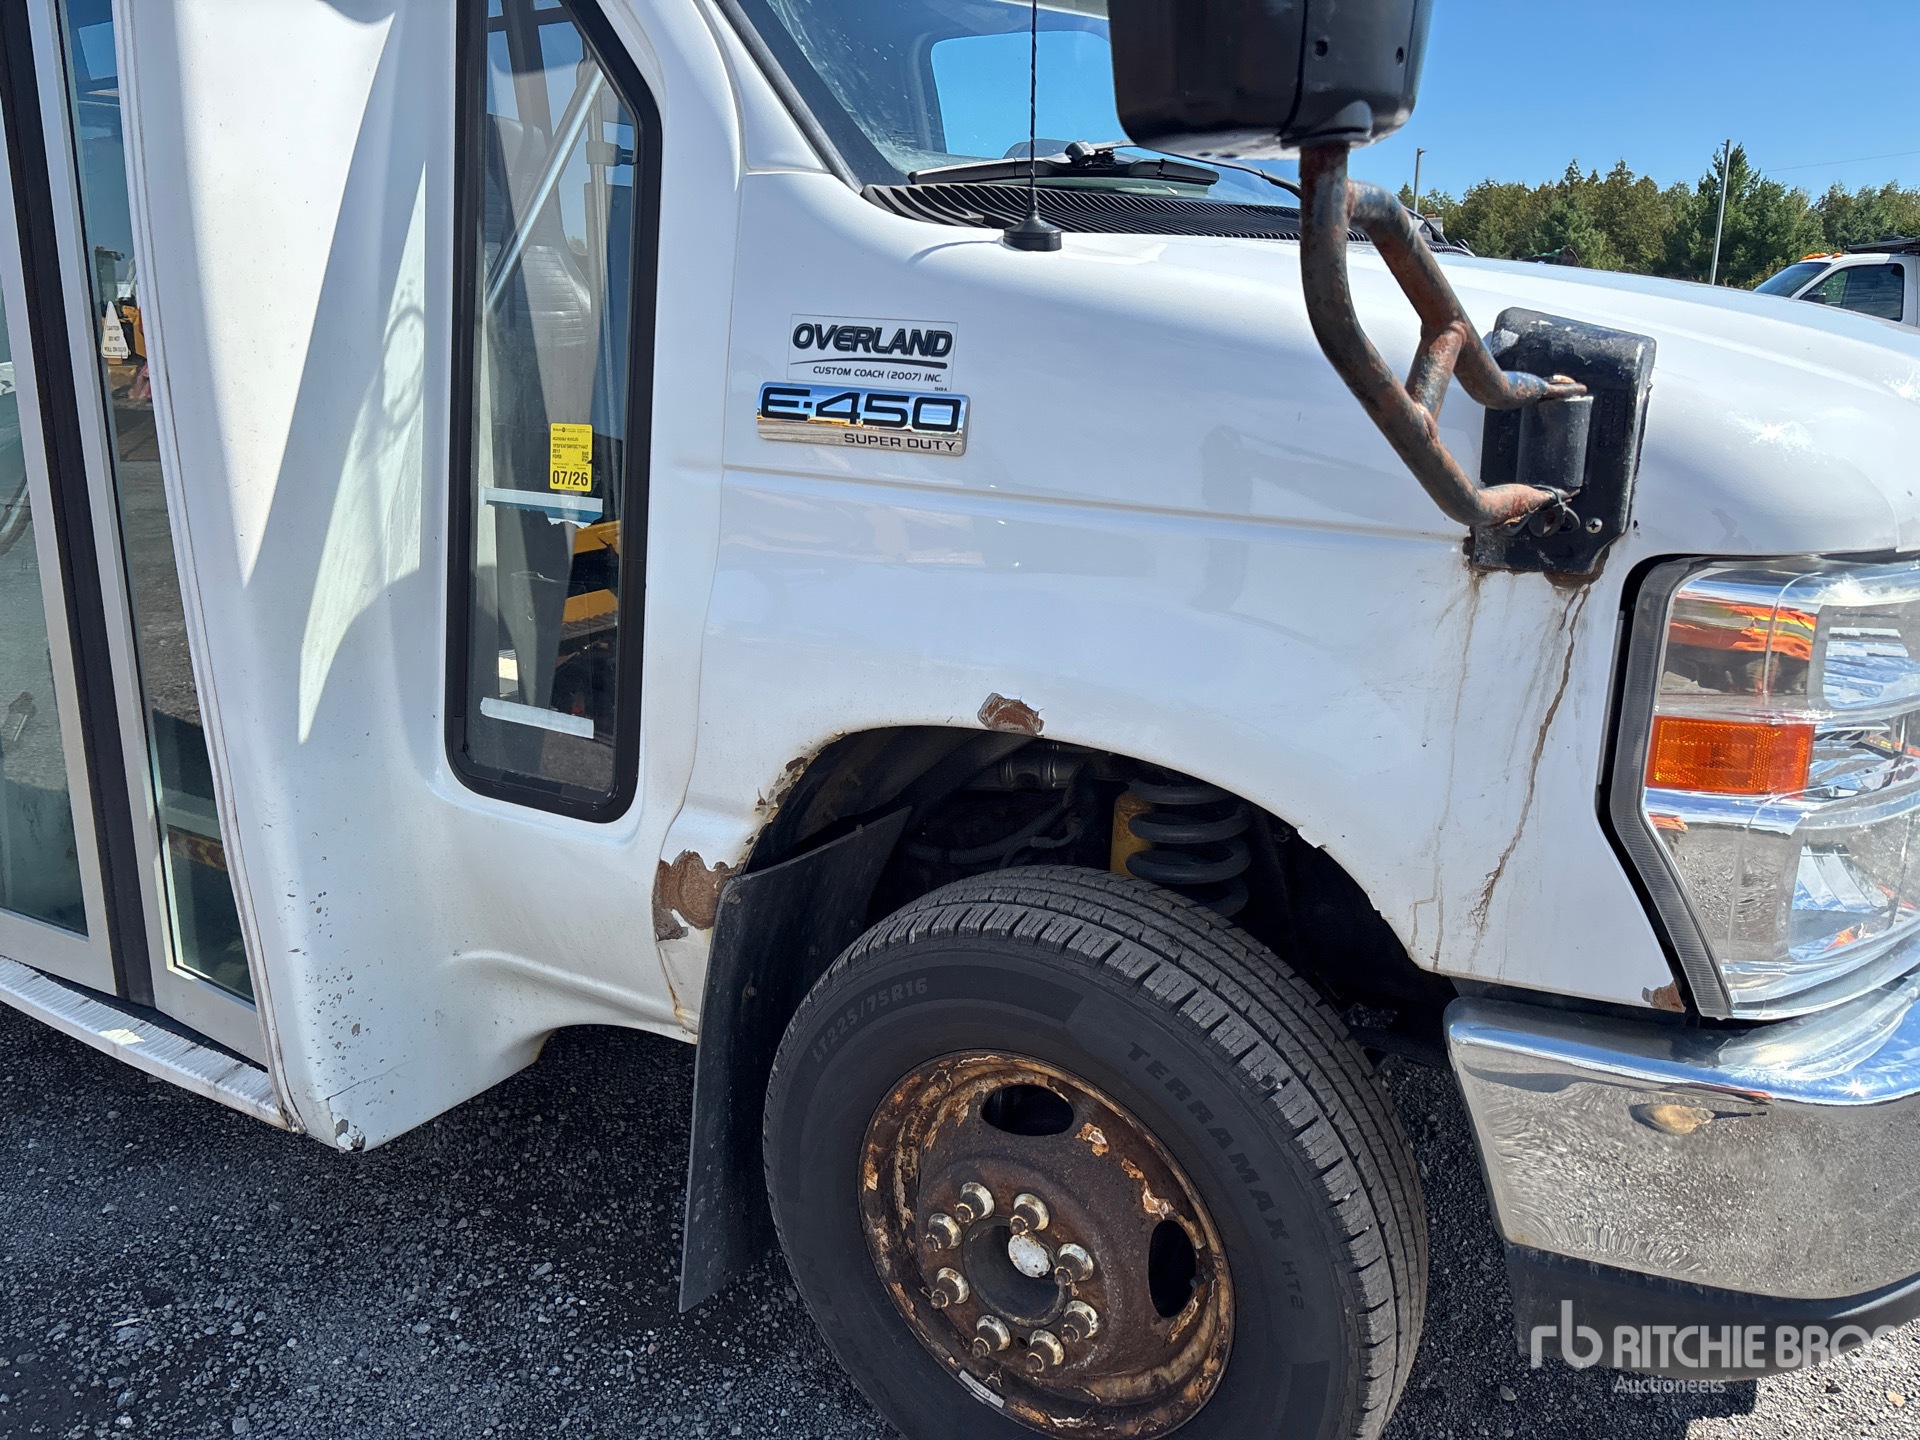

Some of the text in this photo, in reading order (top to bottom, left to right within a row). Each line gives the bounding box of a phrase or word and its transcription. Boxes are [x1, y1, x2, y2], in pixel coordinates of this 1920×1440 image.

[792, 323, 953, 358] OVERLAND
[813, 366, 943, 383] CUSTOM COACH (2007) INC.
[760, 387, 962, 433] E-450
[844, 433, 956, 451] SUPER DUTY
[552, 470, 588, 486] 07/26
[812, 977, 928, 1064] LT225/75R16
[1127, 1041, 1290, 1241] TERRAMAX
